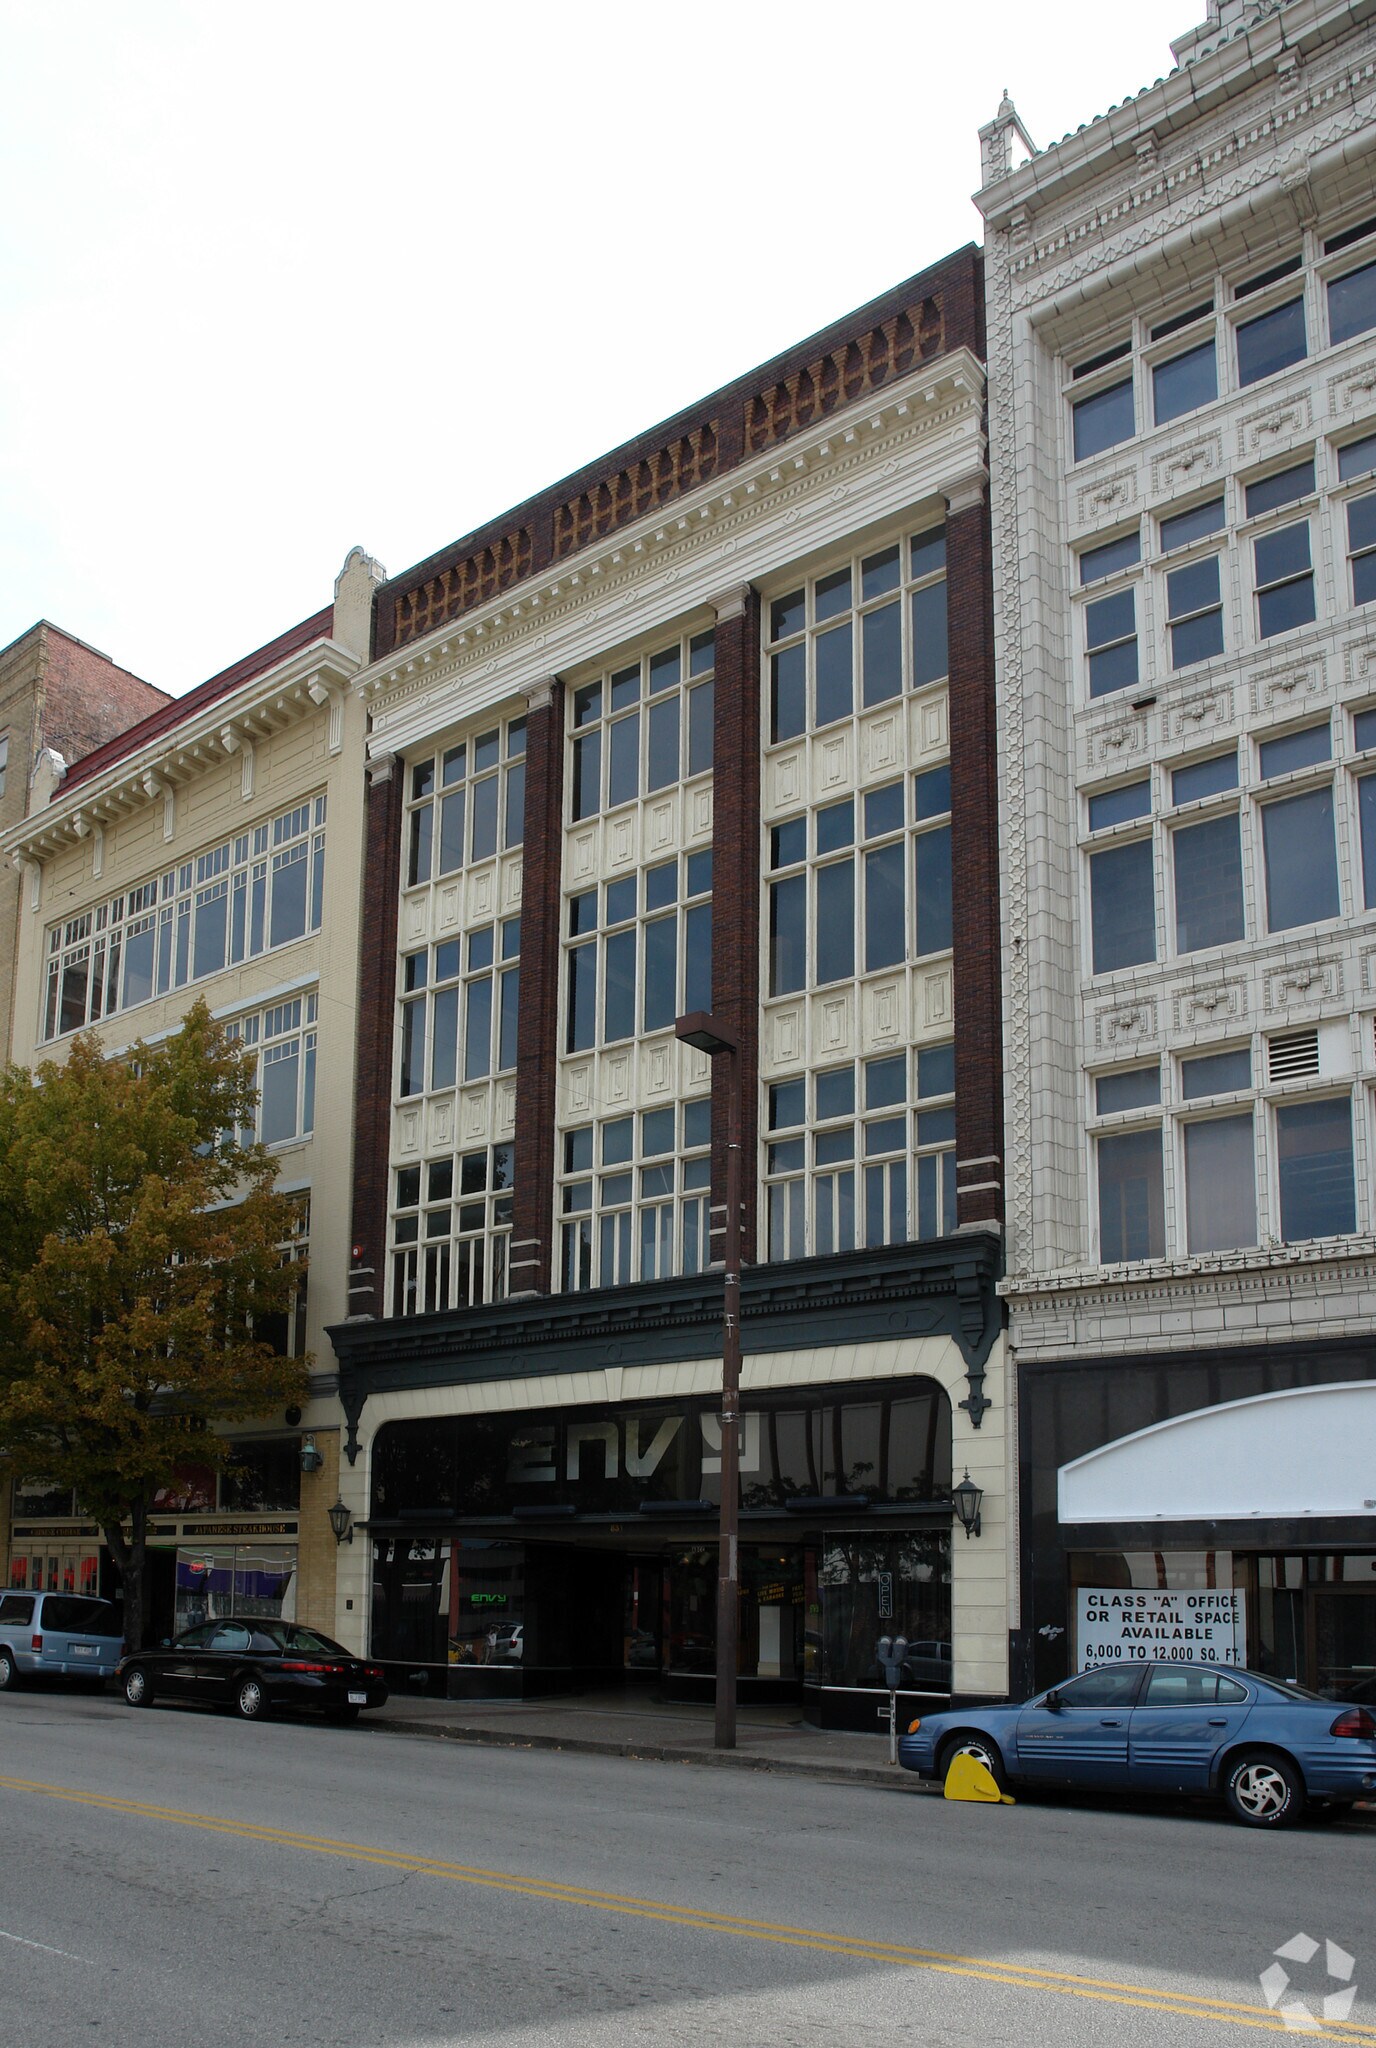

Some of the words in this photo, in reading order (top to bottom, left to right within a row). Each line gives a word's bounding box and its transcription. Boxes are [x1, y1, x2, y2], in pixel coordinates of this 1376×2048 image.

[194, 1525, 232, 1535] JAPANESE
[233, 1523, 286, 1534] STEAKHOUSE
[881, 1575, 890, 1616] OPEN
[1088, 1595, 1146, 1607] CLASS
[1154, 1596, 1178, 1608] "A"
[1187, 1596, 1238, 1608] OFFICE
[1086, 1610, 1110, 1622] OR
[1122, 1611, 1184, 1623] RETAIL
[1195, 1612, 1240, 1624] SPACE
[1121, 1627, 1213, 1640] AVAILABLE
[1086, 1644, 1122, 1659] 6,000
[1128, 1646, 1146, 1658] TO
[1153, 1646, 1193, 1660] 12,000
[1200, 1648, 1219, 1661] SQ.
[1226, 1648, 1241, 1661] FT.
